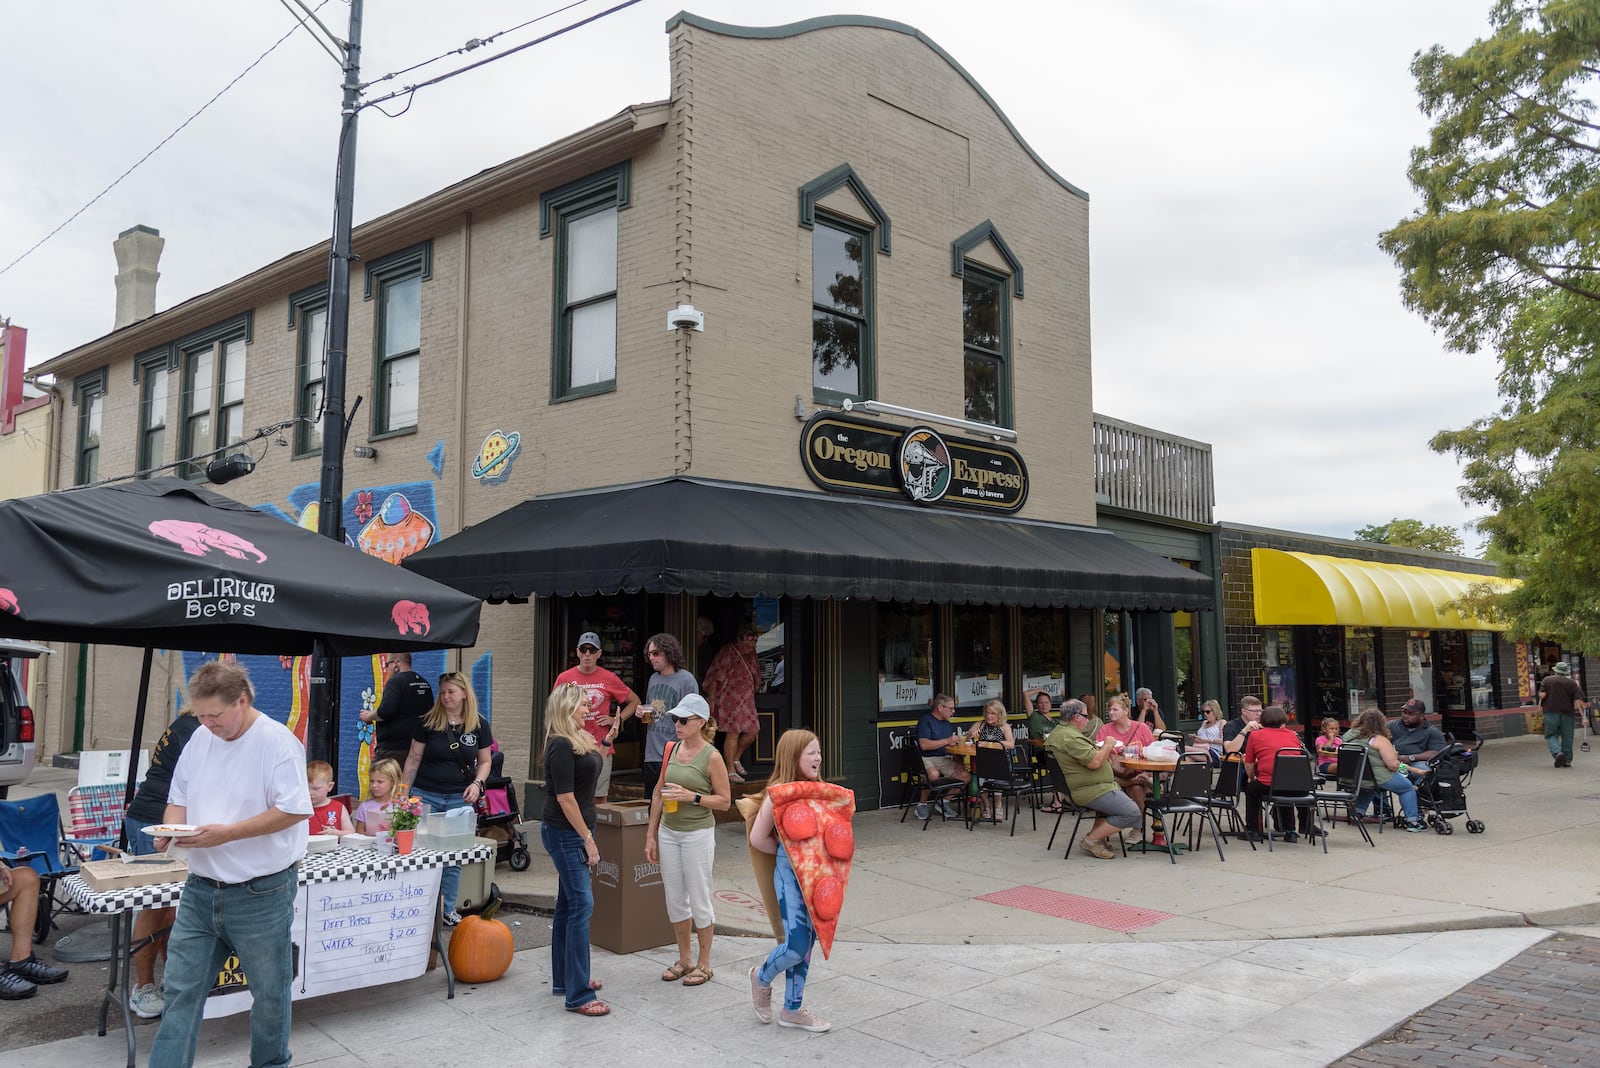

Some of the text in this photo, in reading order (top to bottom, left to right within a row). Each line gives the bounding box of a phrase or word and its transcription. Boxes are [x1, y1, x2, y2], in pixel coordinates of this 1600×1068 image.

[837, 433, 849, 443] the
[814, 436, 892, 472] Oregon
[953, 458, 1021, 489] Express
[962, 486, 1004, 499] pizza tavern
[167, 578, 276, 604] DELIRIUM
[186, 599, 256, 619] Beers
[895, 684, 918, 703] Happy
[971, 682, 988, 697] 40th
[1010, 723, 1030, 741] pirits
[361, 892, 394, 905] SLICES
[321, 938, 354, 952] WATER
[363, 943, 396, 955] TICKETS
